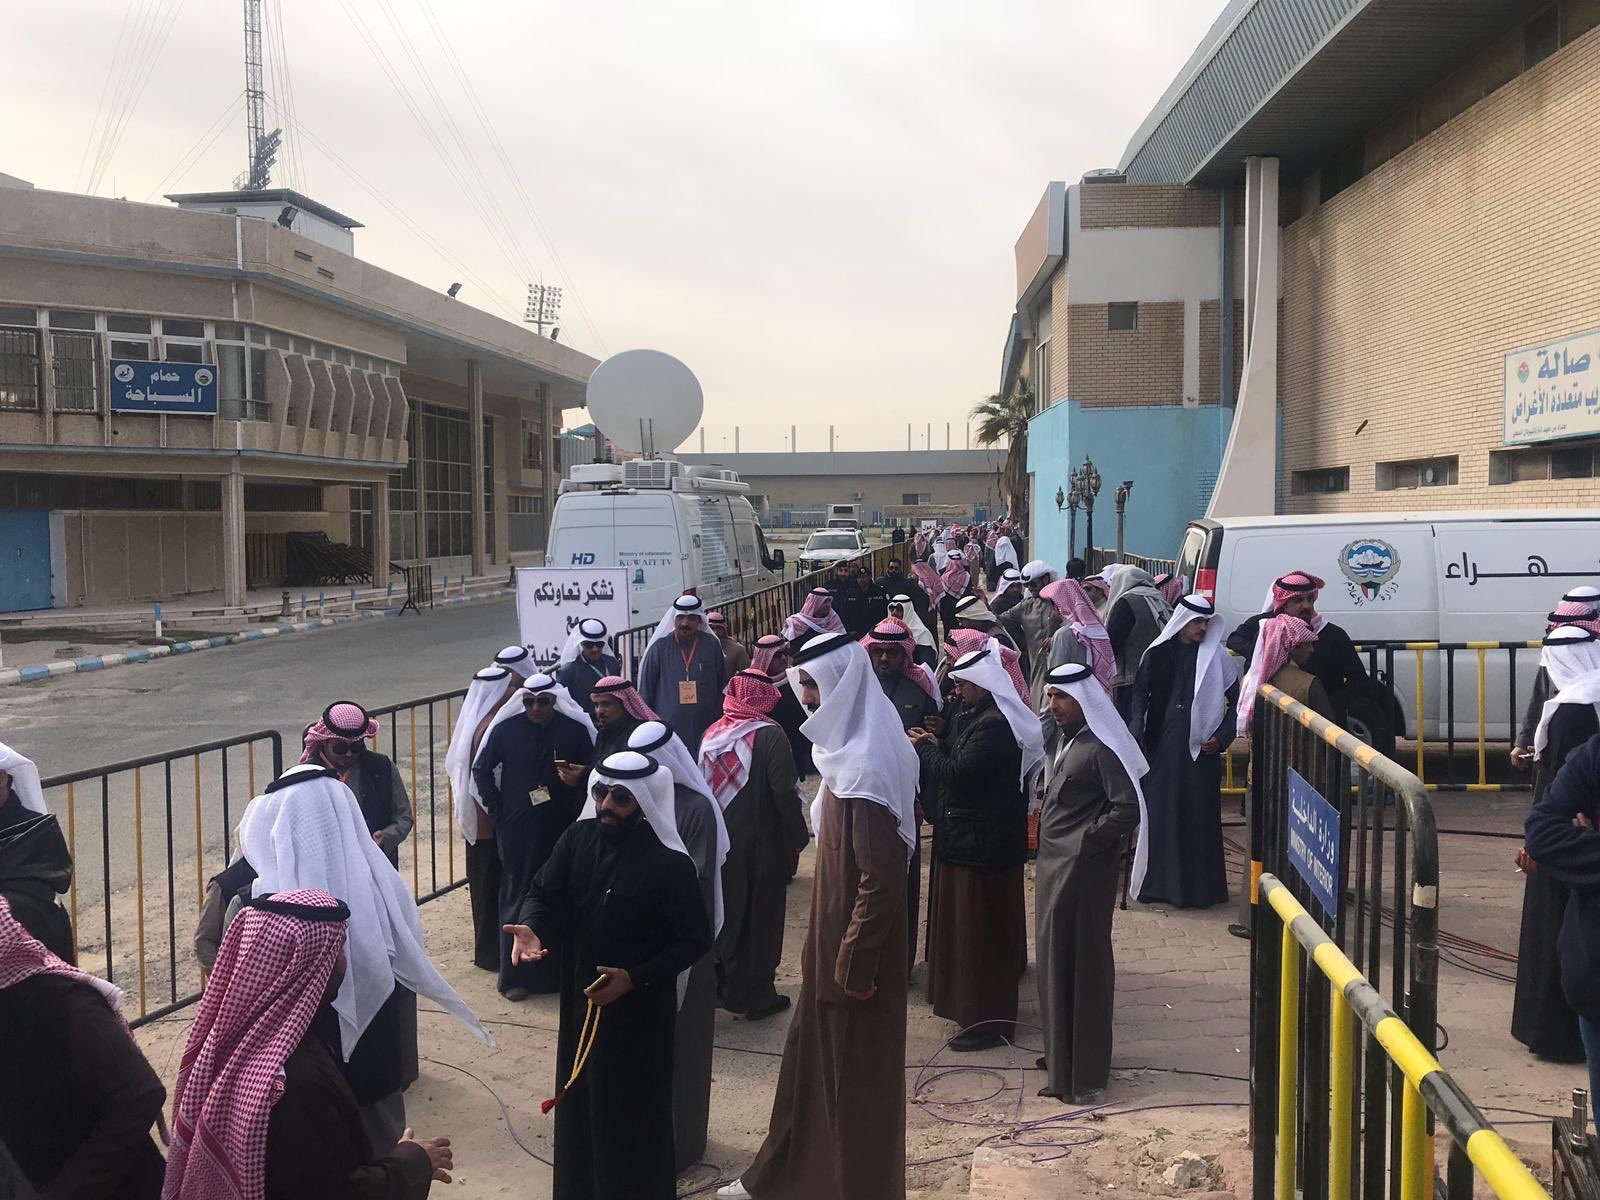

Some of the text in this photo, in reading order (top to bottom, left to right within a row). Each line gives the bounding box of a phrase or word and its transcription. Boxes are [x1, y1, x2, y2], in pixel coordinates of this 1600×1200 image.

[150, 368, 180, 384] حمام
[1537, 348, 1591, 378] صالة
[125, 385, 202, 405] السباحة
[1551, 382, 1582, 413] متعددة
[571, 552, 595, 565] HD
[1445, 552, 1600, 585] هراء
[534, 579, 614, 608] نشكر تعاونكم
[1292, 788, 1335, 864] وزارة الداخلية
[1291, 827, 1333, 897] MINISTRY OF INTERIOR
